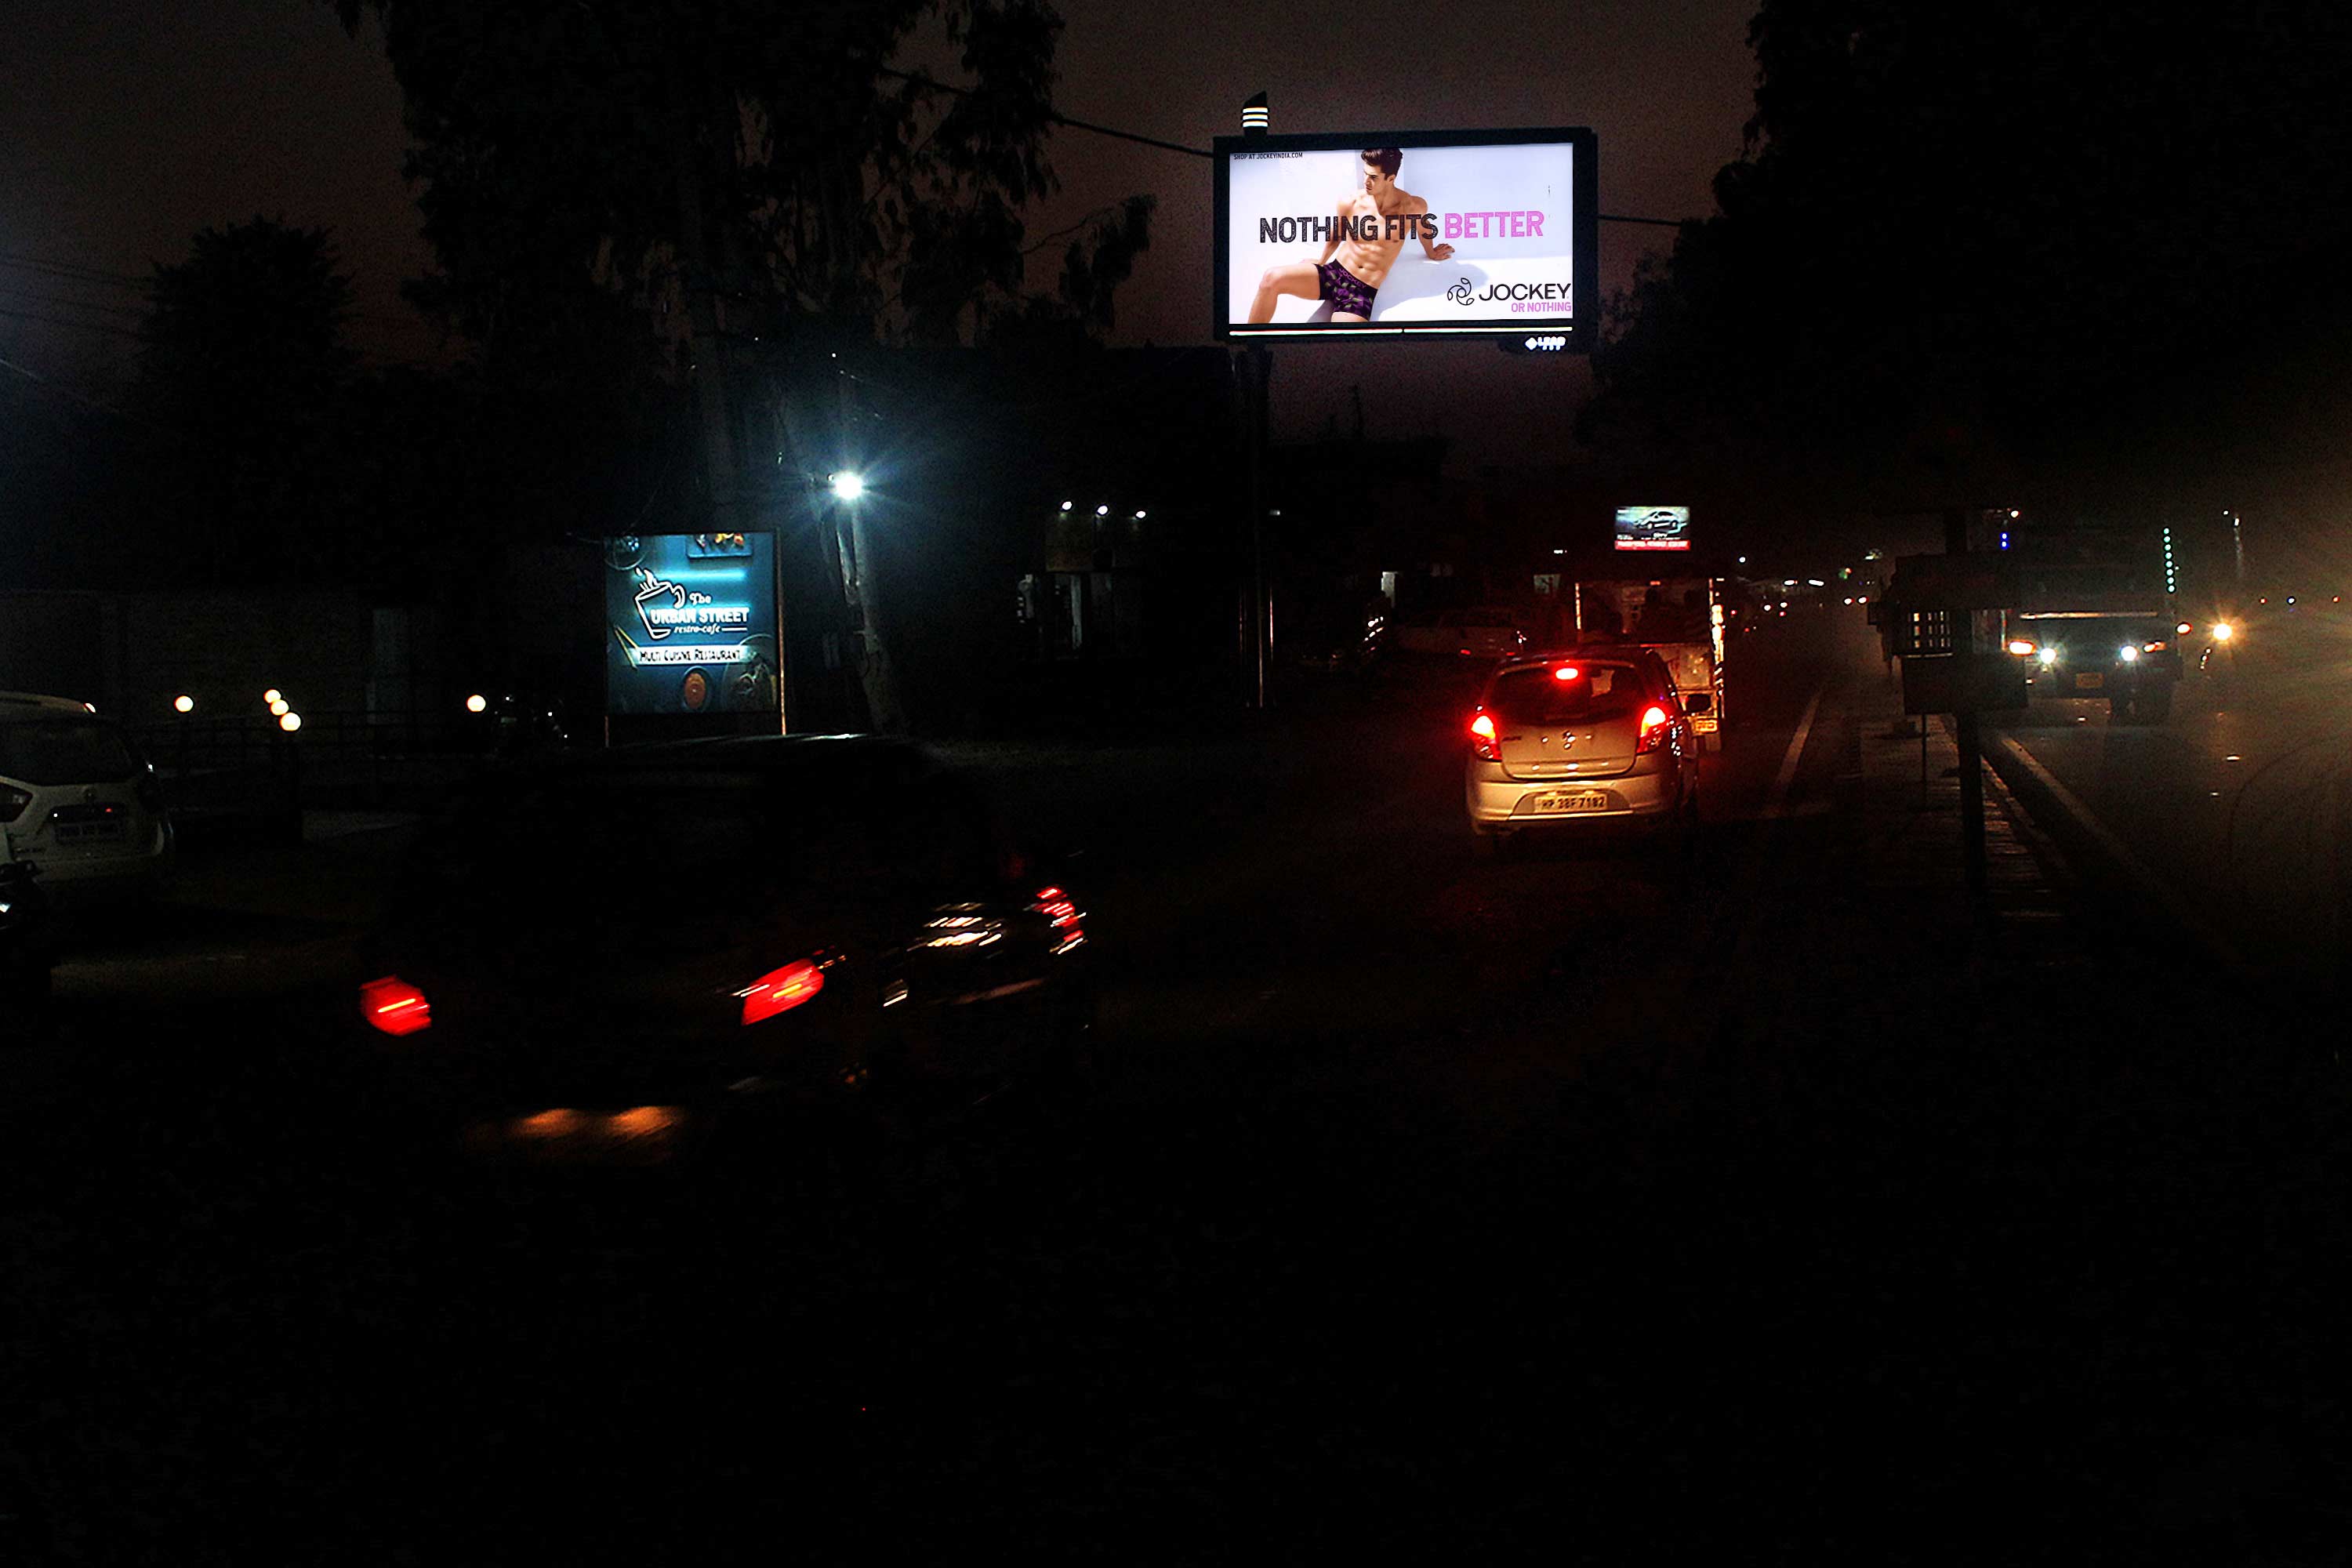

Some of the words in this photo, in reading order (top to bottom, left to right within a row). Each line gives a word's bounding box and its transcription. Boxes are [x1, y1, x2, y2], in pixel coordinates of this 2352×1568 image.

[1259, 214, 1378, 243] NOTHING
[1385, 212, 1439, 241] FITS
[1445, 210, 1544, 239] BETTER
[1479, 283, 1571, 301] JOCKEY
[1511, 303, 1526, 312] OR
[1527, 302, 1572, 312] NOTHING
[650, 608, 697, 624] URBAN
[699, 607, 750, 623] STREET
